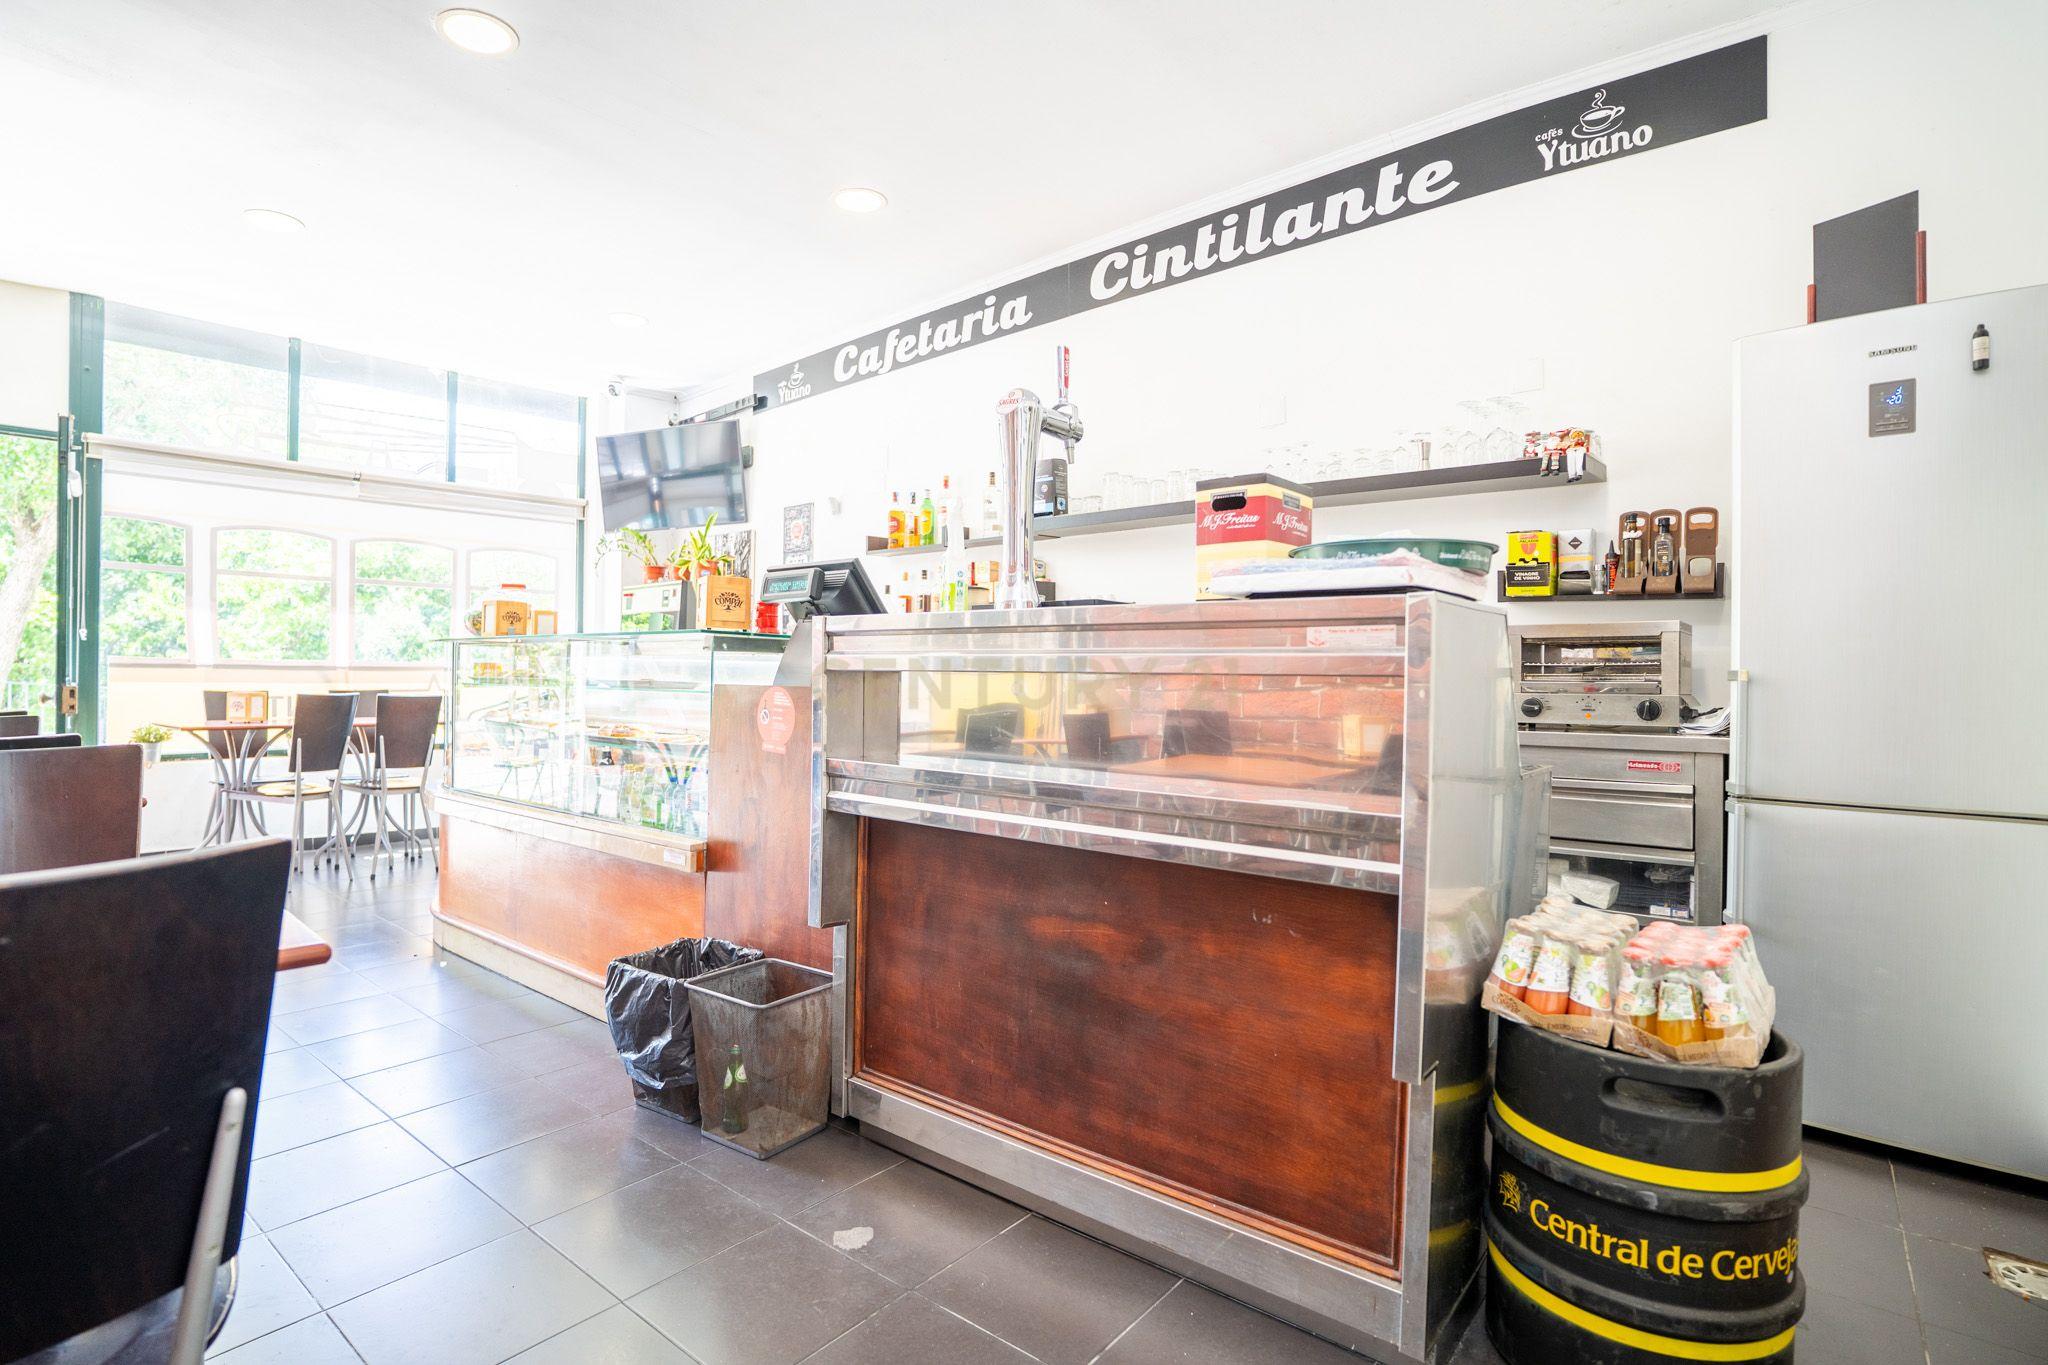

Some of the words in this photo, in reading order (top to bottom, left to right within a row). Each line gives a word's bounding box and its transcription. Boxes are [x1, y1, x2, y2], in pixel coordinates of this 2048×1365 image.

[1535, 128, 1563, 142] cafés
[1537, 125, 1653, 171] Ytuano
[833, 295, 1033, 383] Cafetaria
[1090, 160, 1460, 300] Cintilante
[1530, 1199, 1648, 1270] Central
[1656, 1246, 1703, 1279] de
